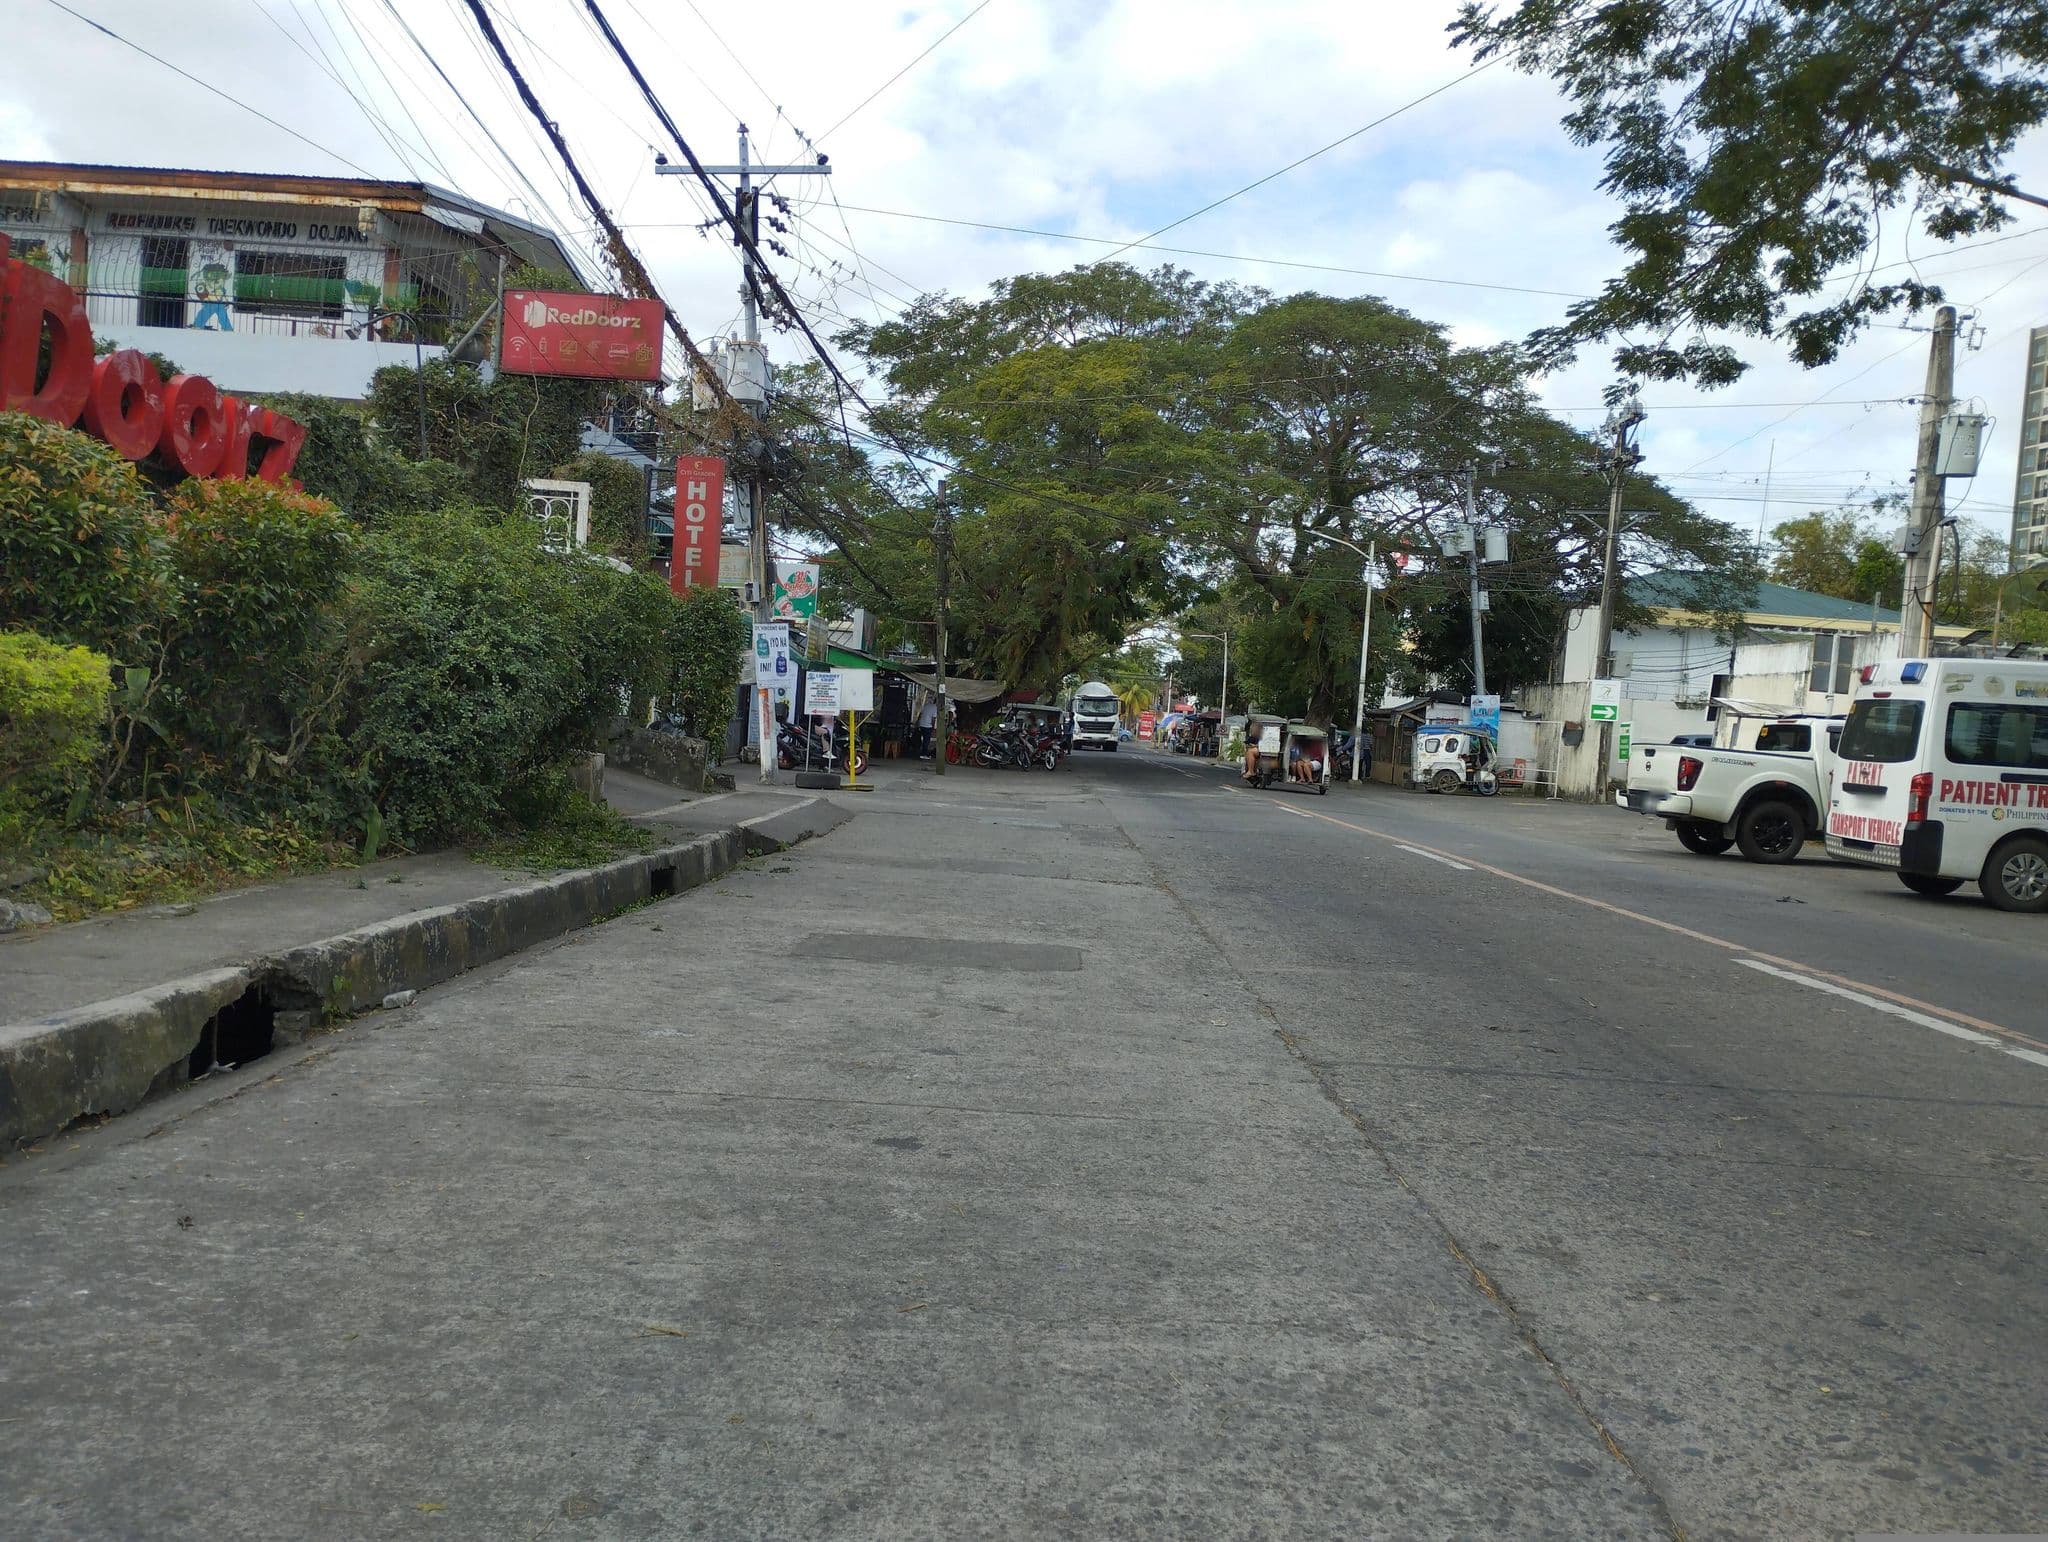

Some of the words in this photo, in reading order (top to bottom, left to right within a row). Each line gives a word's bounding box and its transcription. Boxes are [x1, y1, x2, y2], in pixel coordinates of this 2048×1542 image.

[207, 216, 297, 239] TAEKWONDO
[547, 307, 641, 329] RedDoorz
[685, 480, 707, 588] HOTEL
[1940, 779, 2021, 807] PATIENT
[1938, 806, 1968, 814] DONATED
[1977, 808, 1988, 816] THE
[1831, 812, 1867, 839] TRANSPORT
[1868, 817, 1902, 846] VEHICLE
